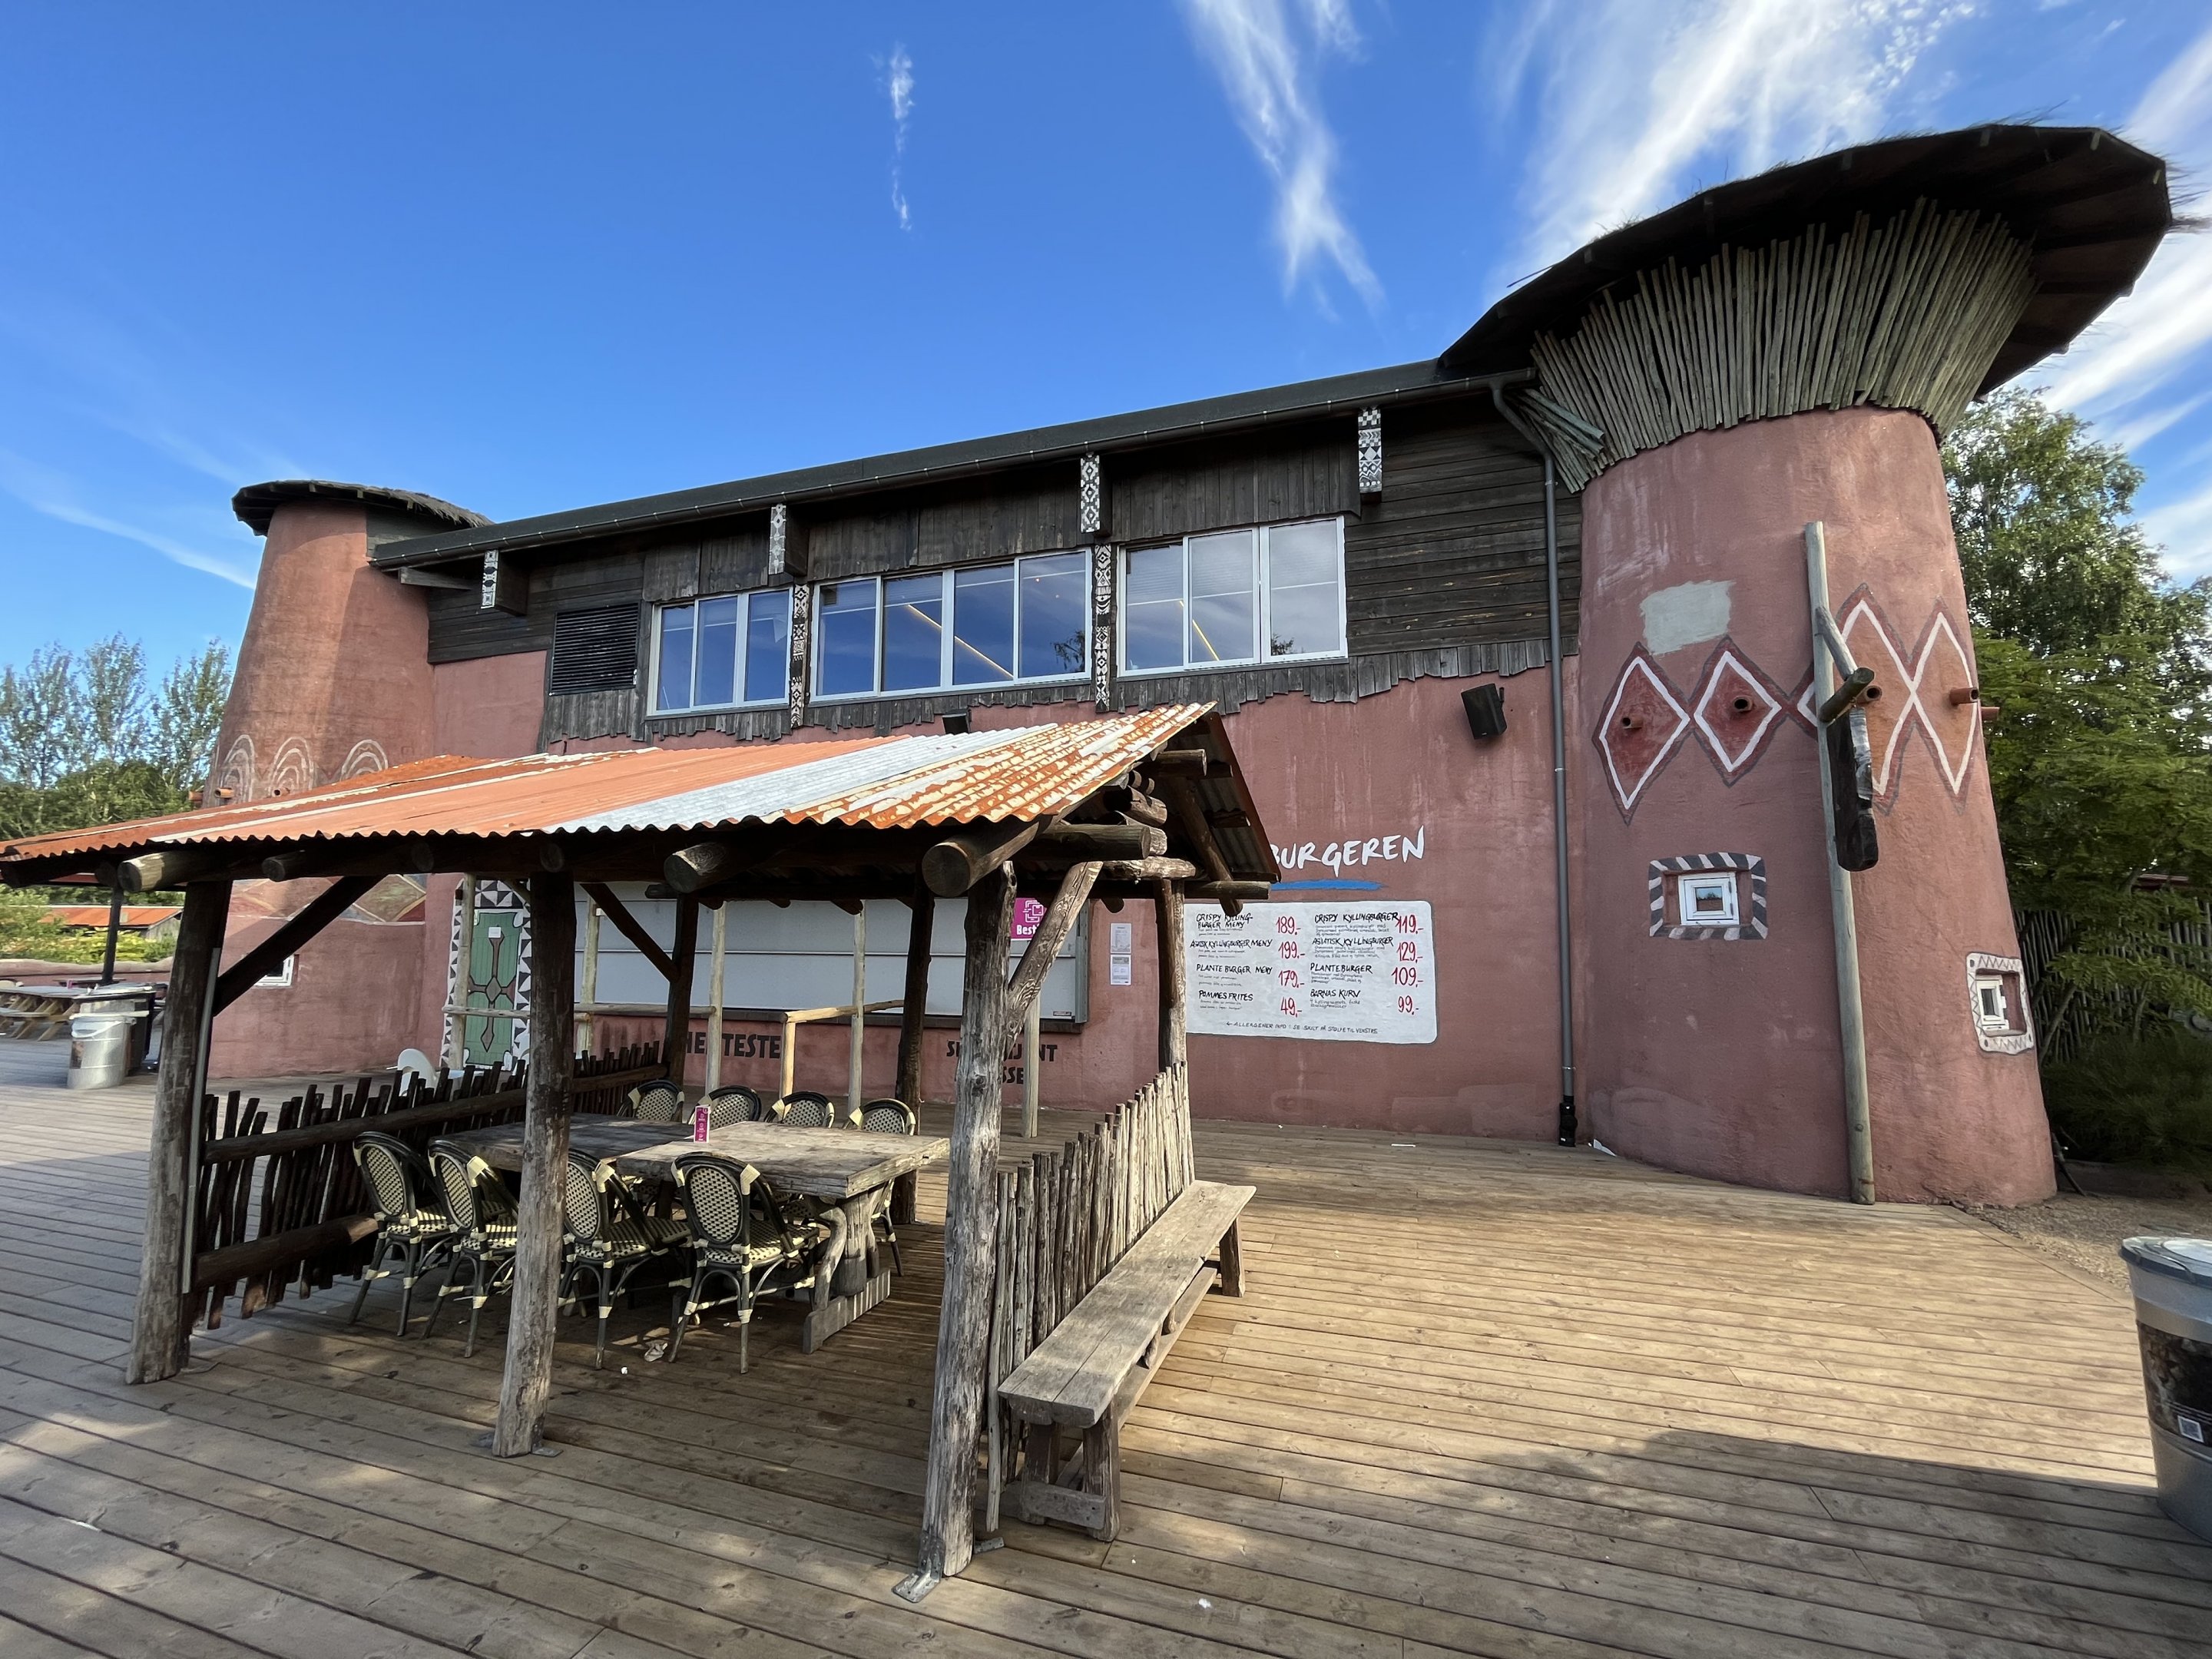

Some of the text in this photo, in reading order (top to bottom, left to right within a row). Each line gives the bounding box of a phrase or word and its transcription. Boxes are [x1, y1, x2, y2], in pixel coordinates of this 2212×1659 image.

[1270, 825, 1424, 877] BURGEREN
[1196, 913, 1221, 922] CRISPY
[1314, 913, 1338, 924] CRISPY
[1016, 923, 1040, 935] Best
[1250, 939, 1273, 947] MENY
[1312, 937, 1343, 947] ASIATISK
[1196, 963, 1273, 975] PLANTE BURGER MENY
[1310, 962, 1373, 975] PLANTEBURGER
[1198, 989, 1253, 1002] POMMES FRITES
[1310, 988, 1361, 999] BARNAS KURV
